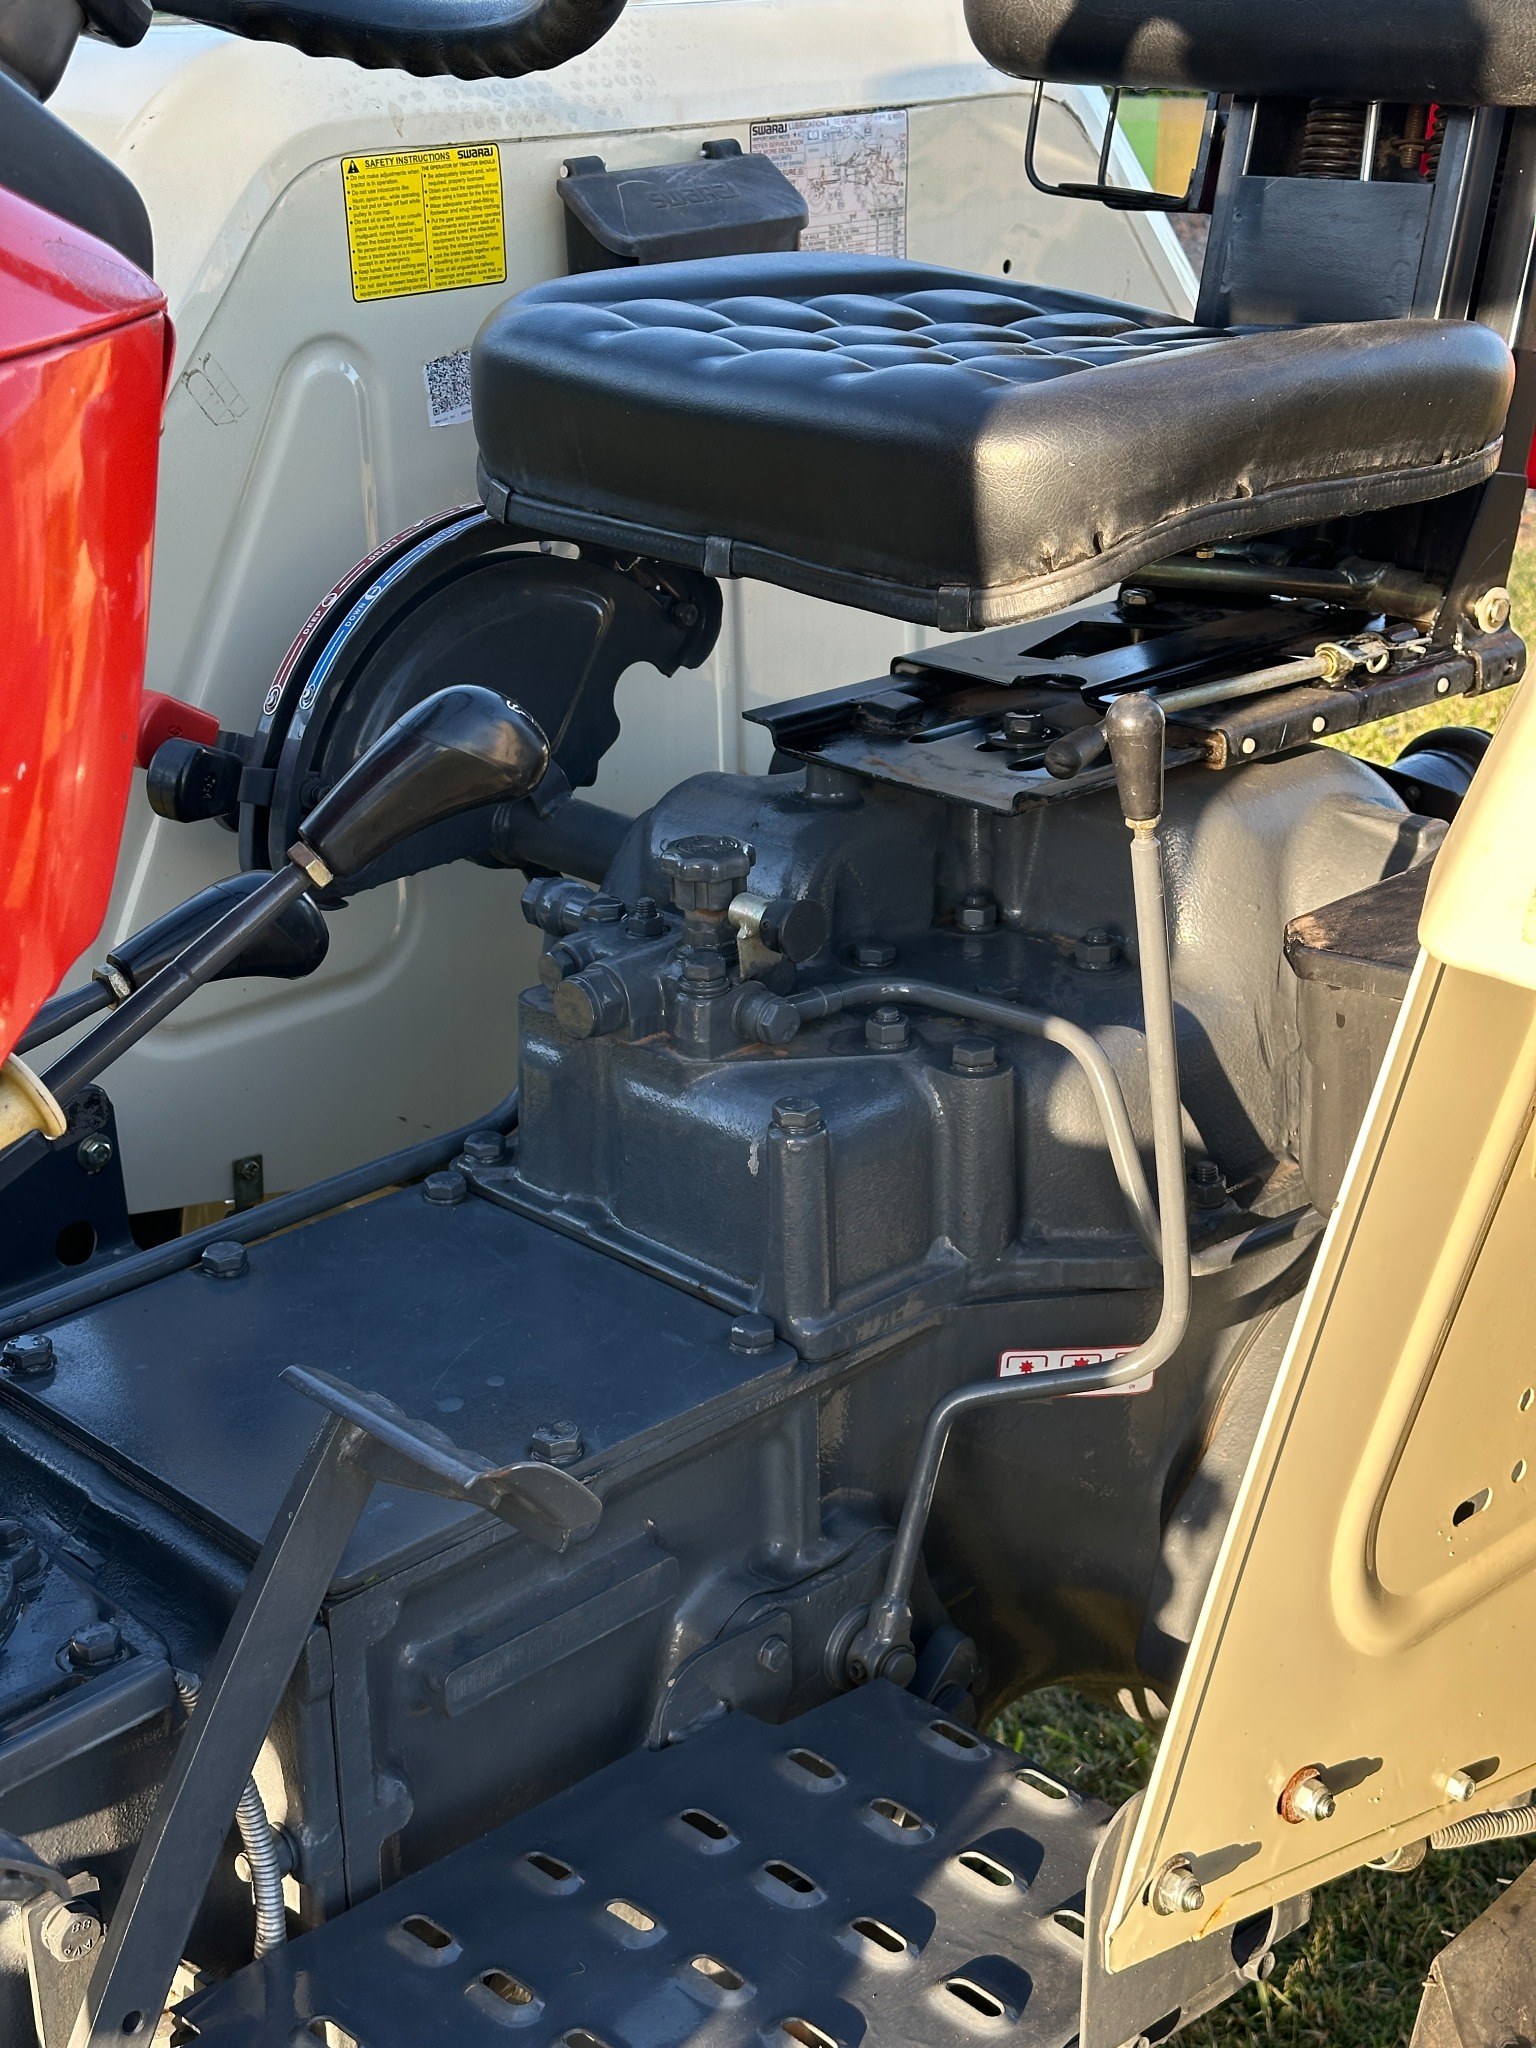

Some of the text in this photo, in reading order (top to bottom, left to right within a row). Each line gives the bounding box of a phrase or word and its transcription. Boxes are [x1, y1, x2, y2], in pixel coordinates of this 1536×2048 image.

[365, 158, 394, 168] SAFETY
[395, 152, 450, 164] INSTRUCTIONS
[422, 525, 463, 549] POSITION
[367, 539, 399, 561] DRAFT
[303, 610, 322, 635] DEEP
[344, 602, 366, 627] DOWN
